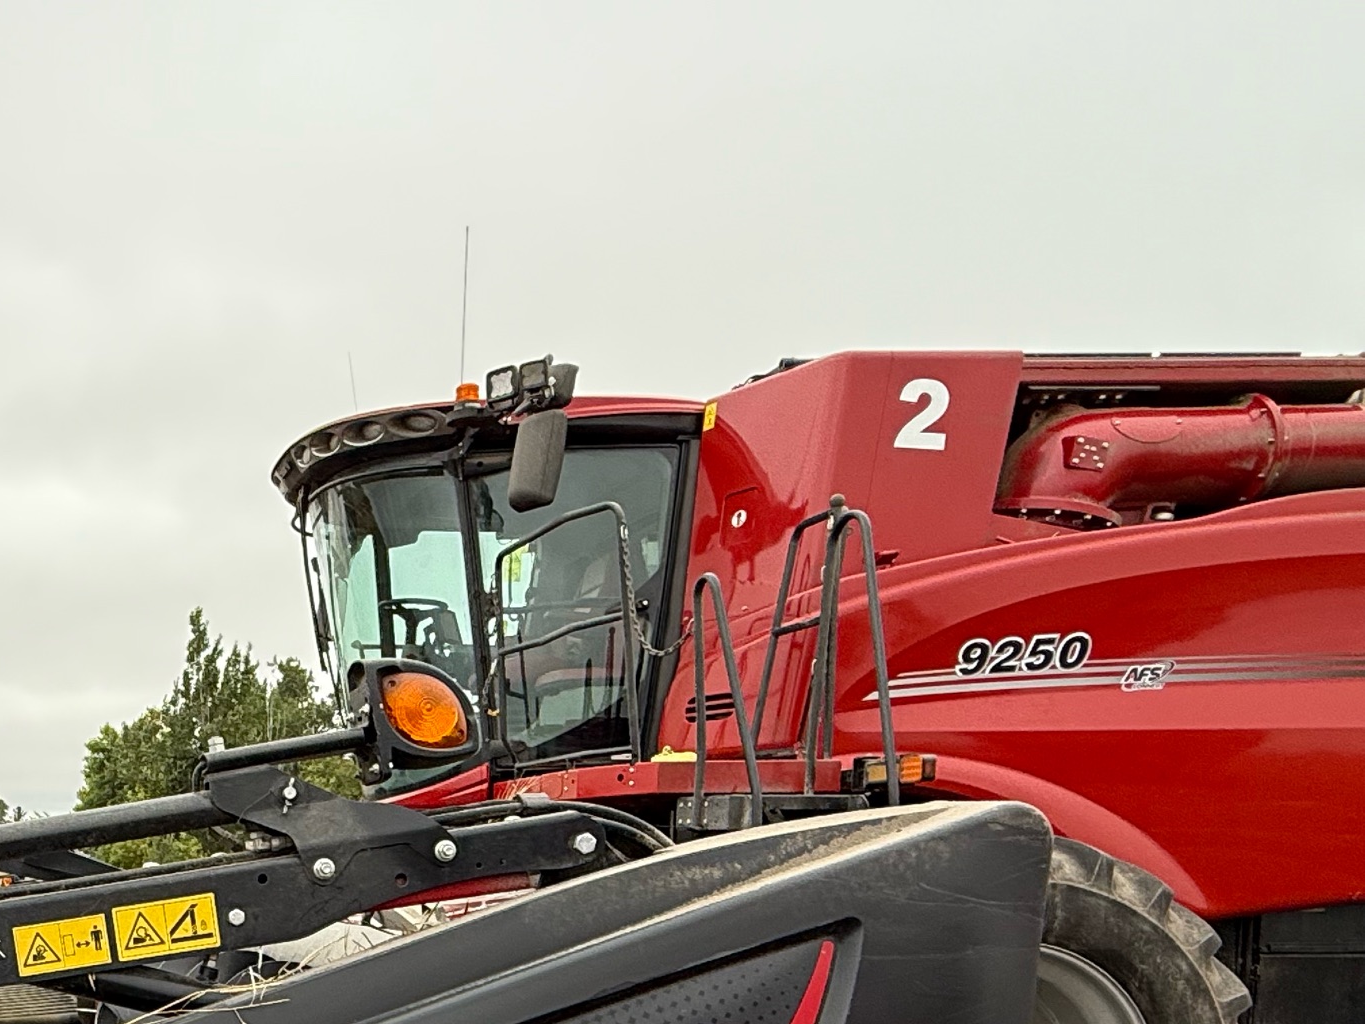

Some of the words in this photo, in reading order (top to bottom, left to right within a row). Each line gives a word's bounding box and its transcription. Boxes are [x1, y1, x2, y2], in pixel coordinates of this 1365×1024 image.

[893, 378, 950, 450] 2
[957, 632, 1091, 677] 9250
[1123, 666, 1163, 682] AFS
